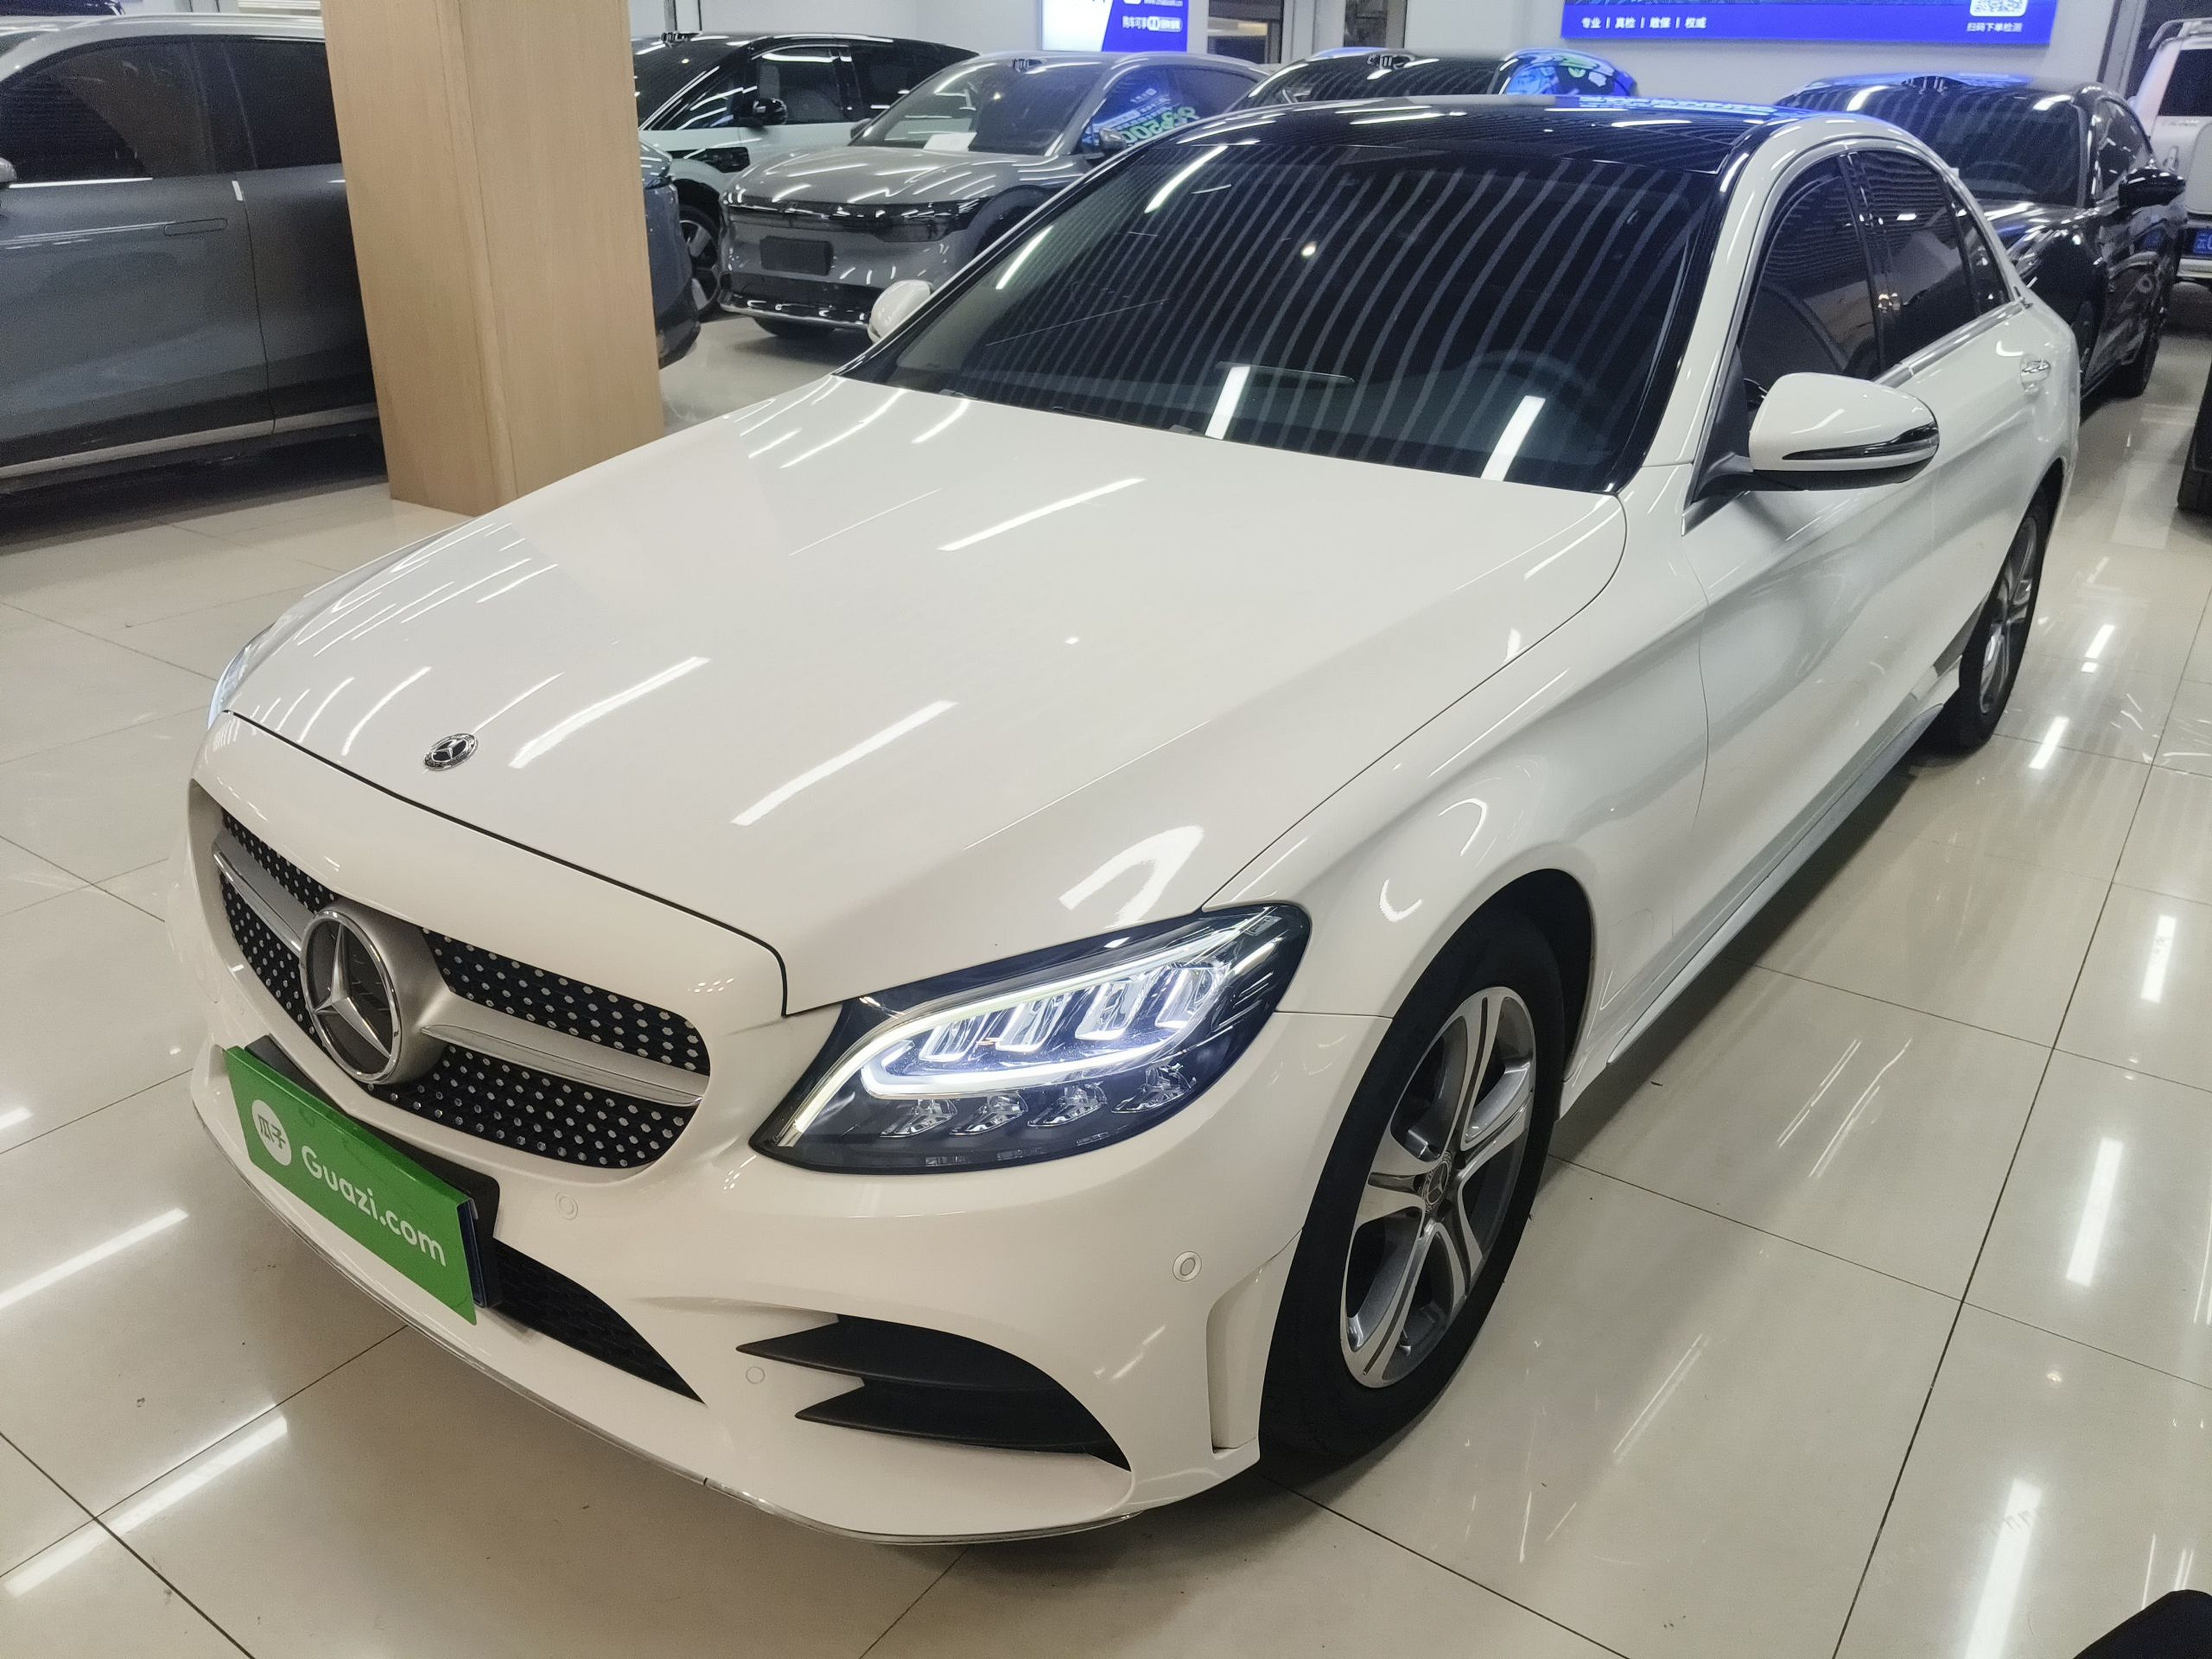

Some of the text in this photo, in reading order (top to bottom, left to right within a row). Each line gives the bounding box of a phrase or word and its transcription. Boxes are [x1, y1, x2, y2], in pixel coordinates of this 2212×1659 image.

[1581, 17, 1601, 28] 专业
[1685, 17, 1707, 29] 权威
[1966, 22, 2024, 33] 扫码下单检测
[257, 1114, 286, 1149] 瓜子
[301, 1145, 446, 1267] Guazi.com
